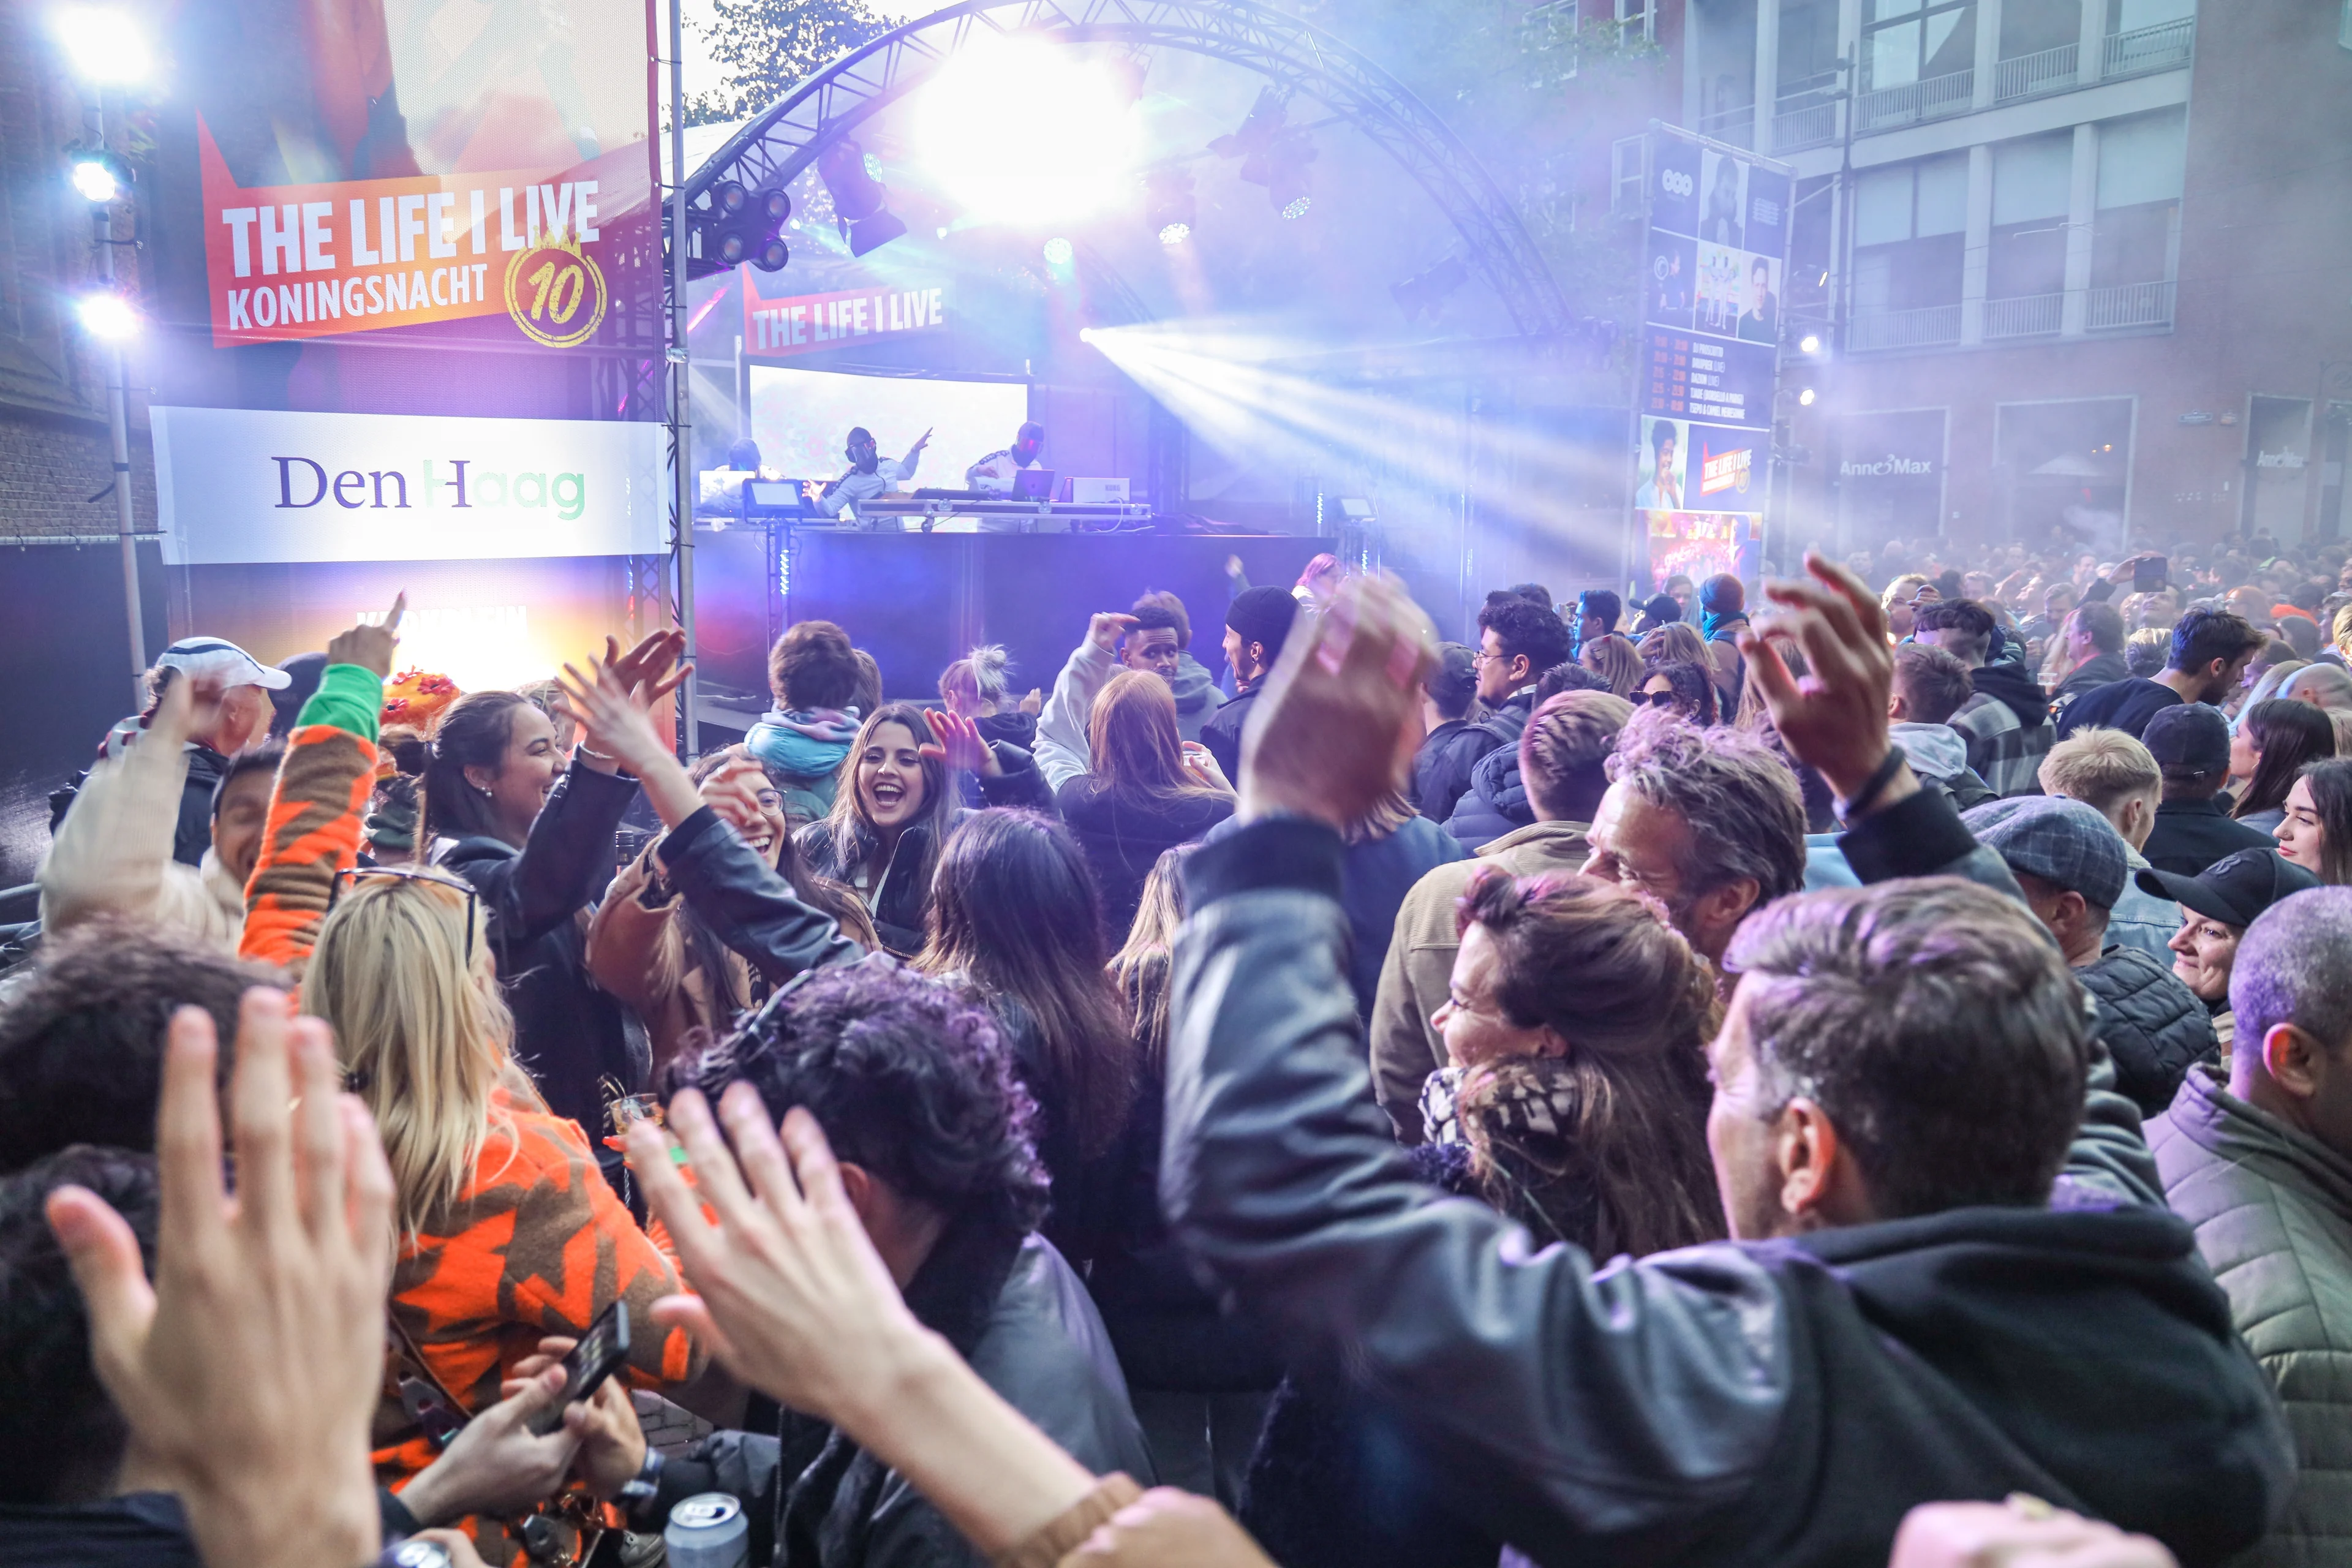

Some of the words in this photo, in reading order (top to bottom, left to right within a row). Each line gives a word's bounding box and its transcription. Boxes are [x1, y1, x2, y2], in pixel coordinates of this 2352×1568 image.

[222, 201, 336, 277] THE
[350, 191, 458, 268] LIFE
[470, 190, 489, 254] I
[500, 179, 600, 251] LIVE
[228, 263, 488, 331] KONINGSNACHT
[529, 261, 586, 325] 10
[753, 306, 807, 350] THE
[813, 297, 869, 344] LIFE
[875, 294, 883, 333] I
[890, 288, 943, 330] LIVE
[271, 456, 413, 510] Den
[423, 459, 586, 521] Haag
[1704, 460, 1719, 480] THE
[1718, 455, 1733, 475] LIFE
[1736, 449, 1752, 469] LIVE
